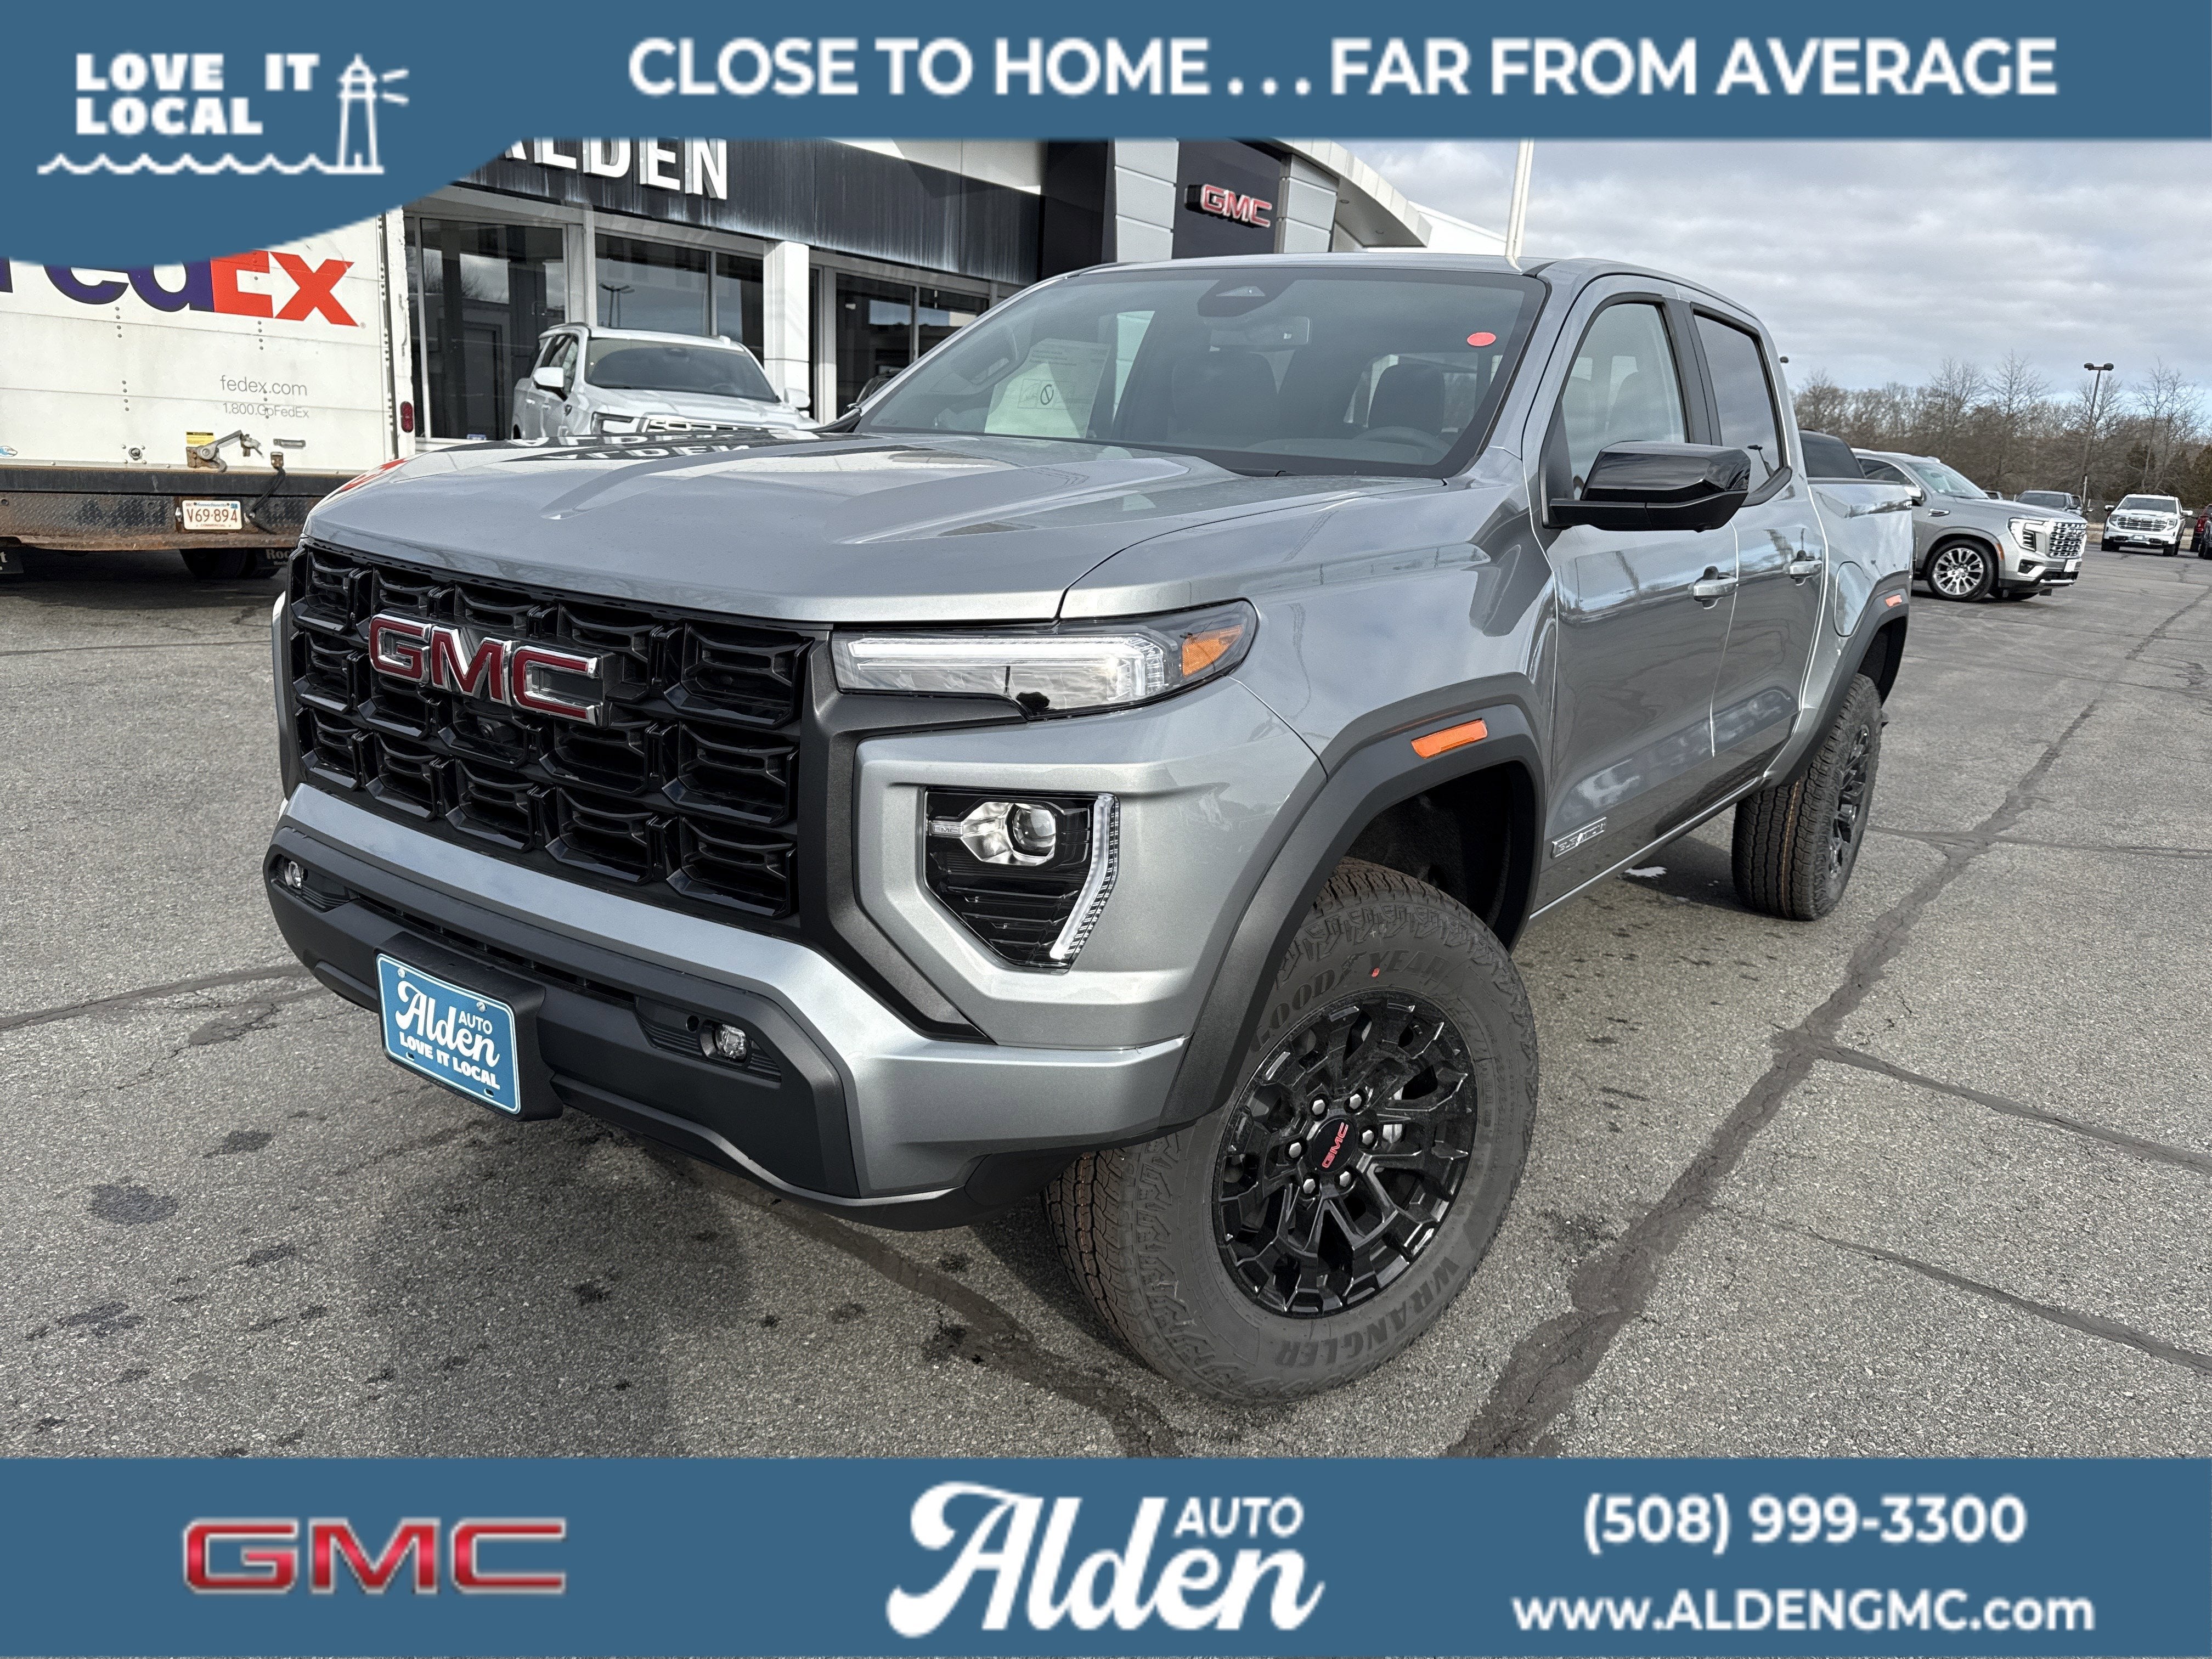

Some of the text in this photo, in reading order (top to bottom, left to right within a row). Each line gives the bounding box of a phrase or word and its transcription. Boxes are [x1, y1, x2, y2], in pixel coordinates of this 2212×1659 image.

[1200, 184, 1272, 228] GMC
[220, 375, 307, 396] fedex.com
[223, 403, 309, 418] 1.800.GoFedEx
[369, 613, 599, 726] GMC
[396, 980, 500, 1067] Alden
[458, 1011, 492, 1035] AUTO
[399, 1031, 500, 1090] LOVE IT LOCAL
[1322, 1122, 1348, 1169] GMC
[1275, 1256, 1460, 1367] WRANGLER
